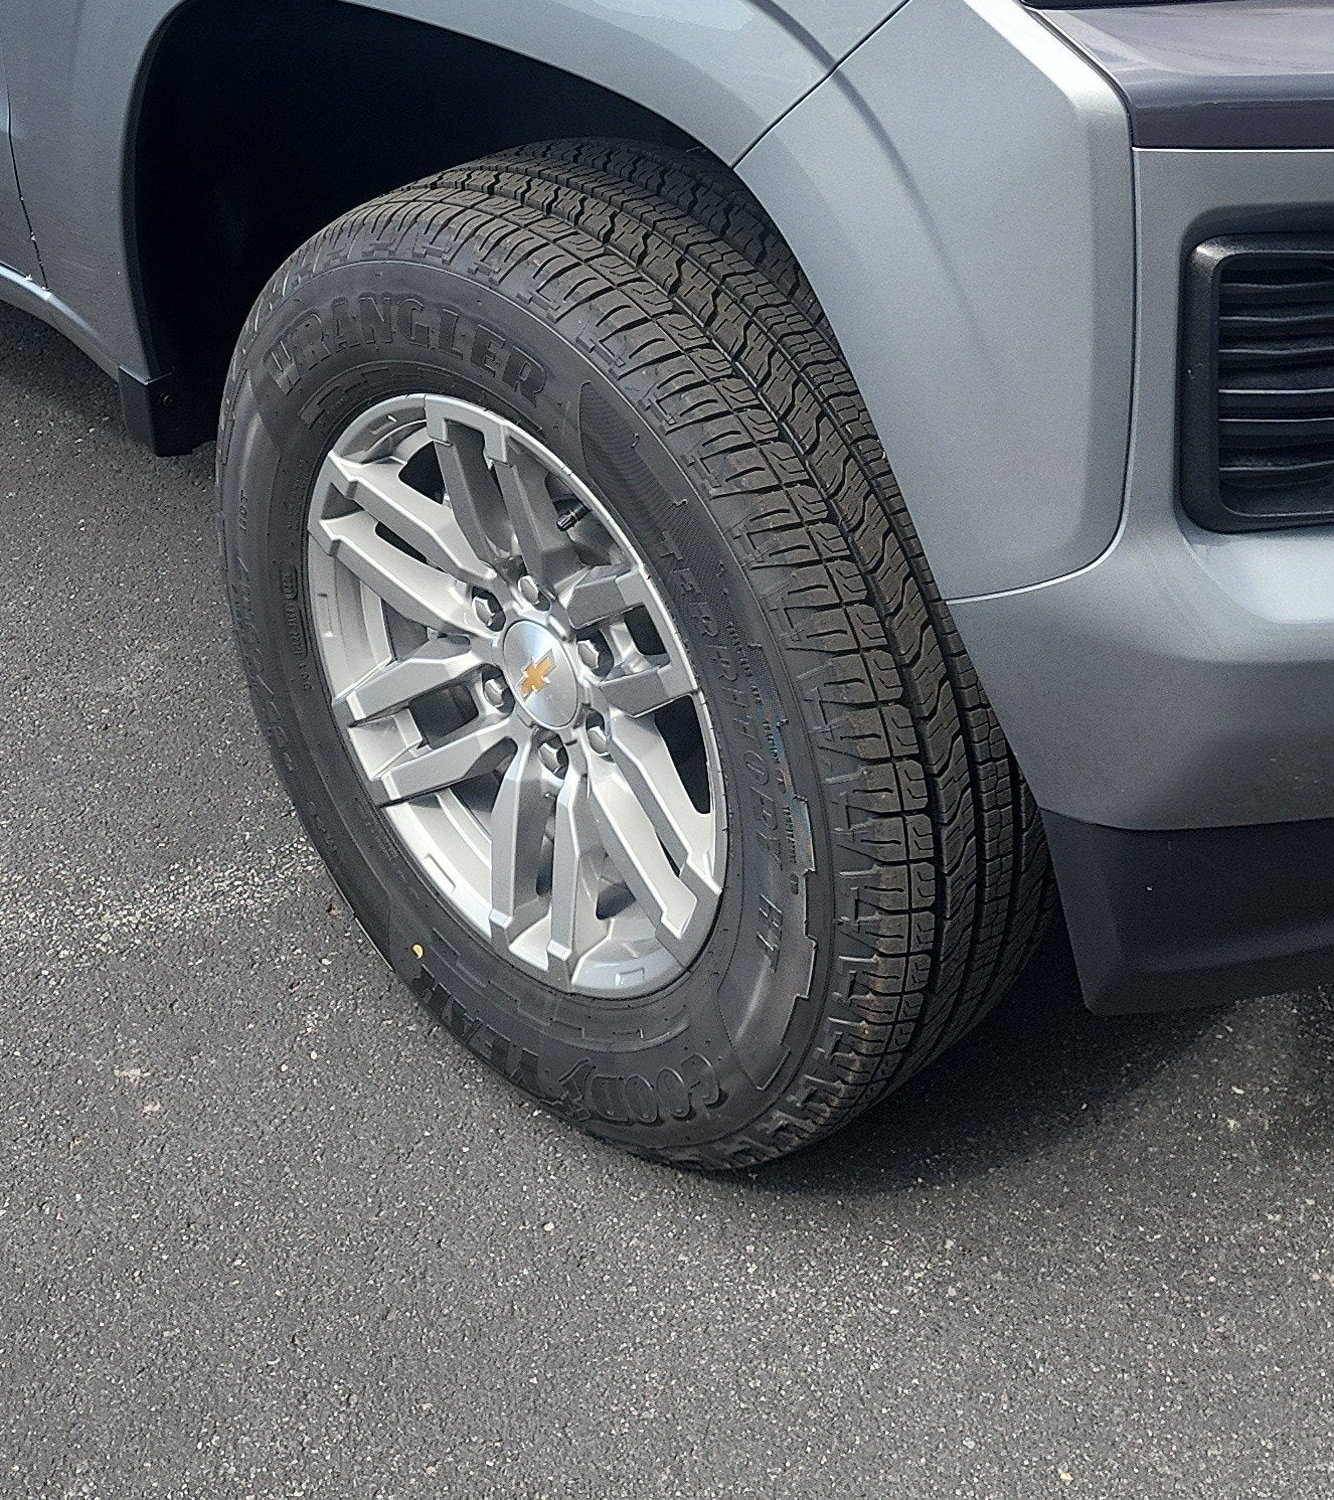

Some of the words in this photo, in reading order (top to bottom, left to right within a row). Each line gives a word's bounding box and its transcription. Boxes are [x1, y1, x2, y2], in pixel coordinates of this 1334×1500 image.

[263, 292, 547, 409] WRANGLER
[659, 530, 784, 871] TERRITORY
[755, 892, 784, 974] HT
[410, 964, 721, 1124] GOODYEAR
